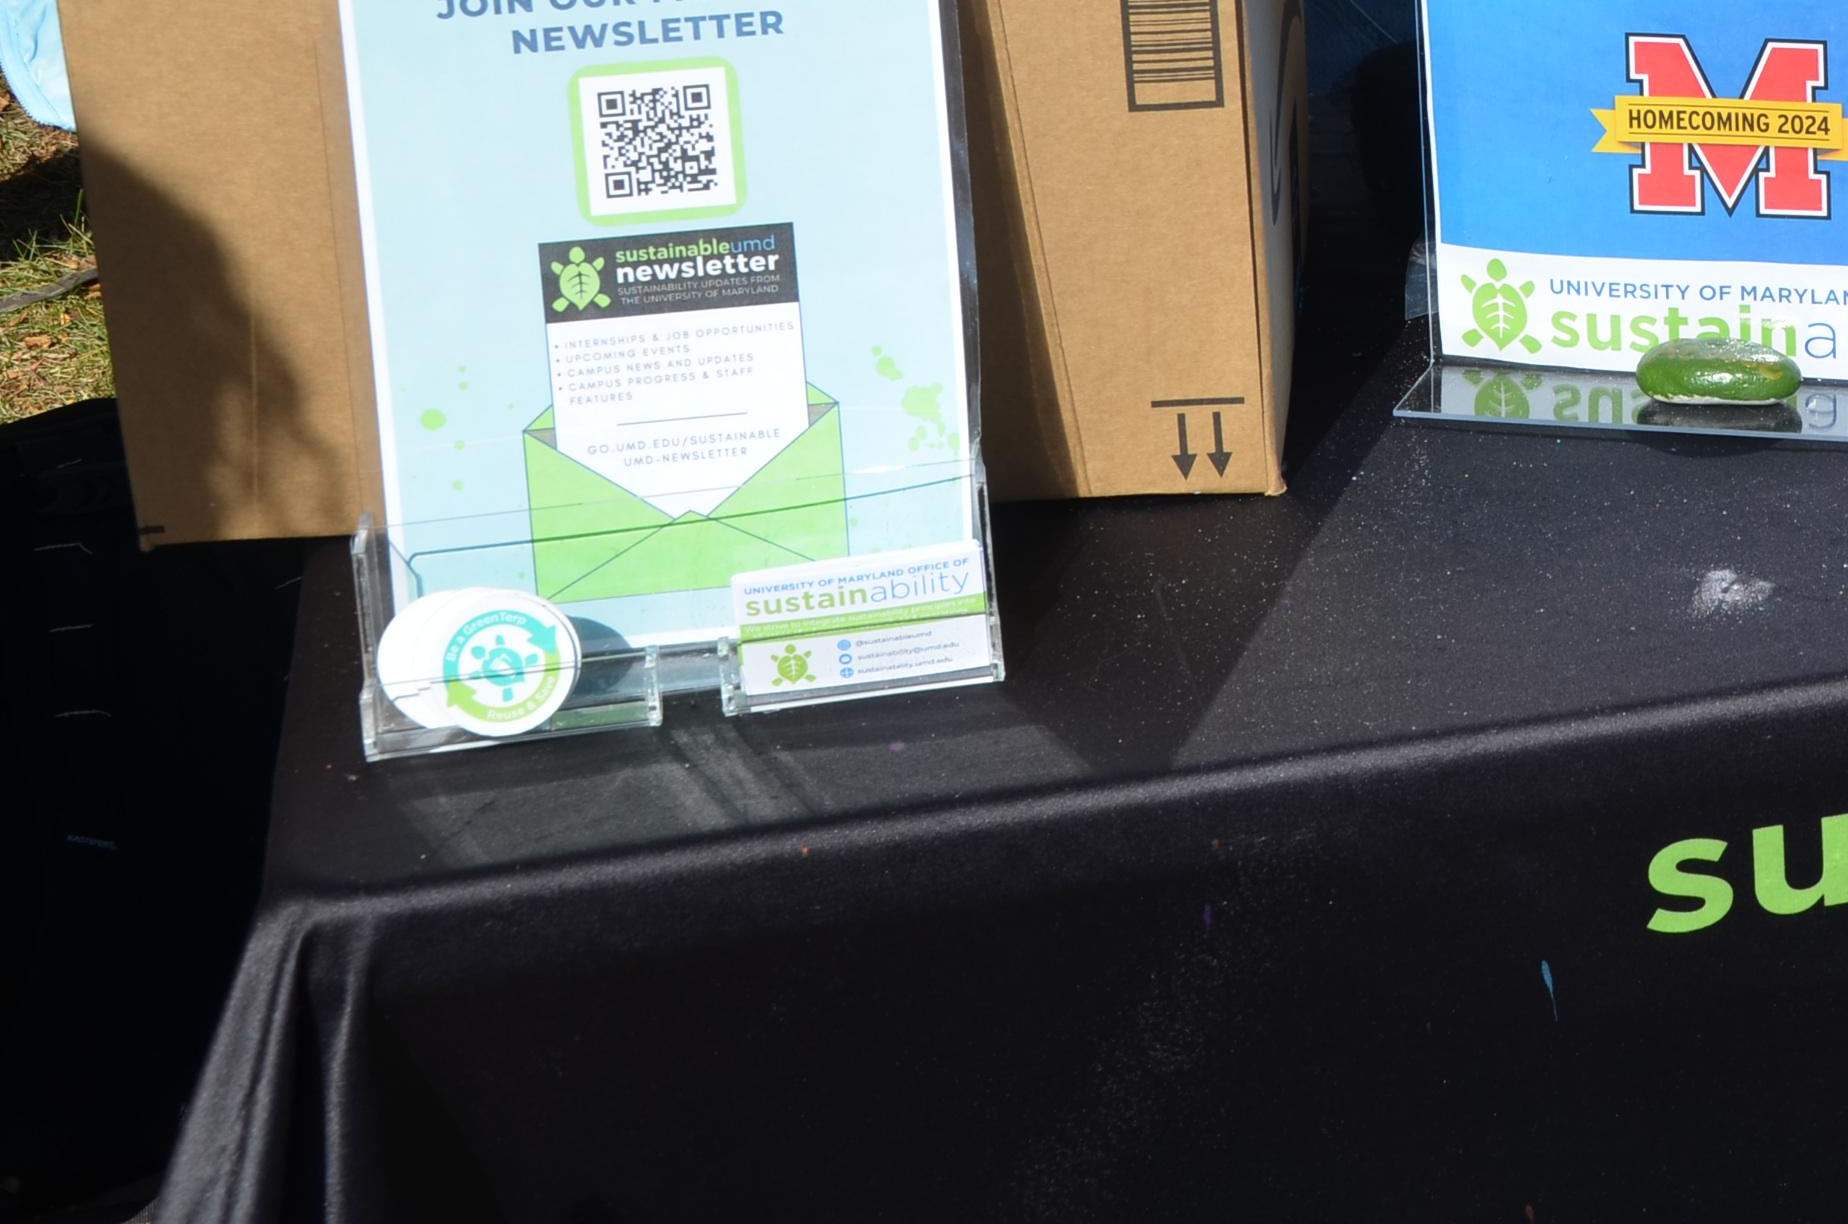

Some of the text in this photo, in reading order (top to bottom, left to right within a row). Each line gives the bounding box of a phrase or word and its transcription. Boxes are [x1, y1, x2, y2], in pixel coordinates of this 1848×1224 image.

[510, 10, 784, 55] NEWSLETTER
[1624, 32, 1832, 220] M
[1628, 108, 1831, 136] HOMECOMING 2024
[616, 235, 775, 263] sustainableumd
[616, 254, 780, 283] newsletter
[618, 275, 780, 296] SUSTAINABILITY UPDATES FROM
[620, 284, 779, 305] THE UNIVERSITY OF MARYLAND
[1549, 278, 1692, 302] UNIVERSITY
[1699, 282, 1736, 302] OF
[564, 321, 794, 349] INTERNSHIPS & JOB OPPORTUNITIES
[566, 345, 691, 364] UPCOMING EVENTS
[567, 353, 754, 378] CAMPUS NEWS AND UPDATES
[569, 367, 753, 392] CAMPUS PROGRESS & STAFF
[570, 392, 634, 406] FEATURES
[587, 429, 781, 455] GO.UMD.EDU/SUSTAINABLE
[624, 447, 748, 467] UMD-NEWSLETTER
[744, 558, 969, 595] UNIVERSITY OF MARYLAND OFFICE OF
[745, 571, 969, 617] sustainability
